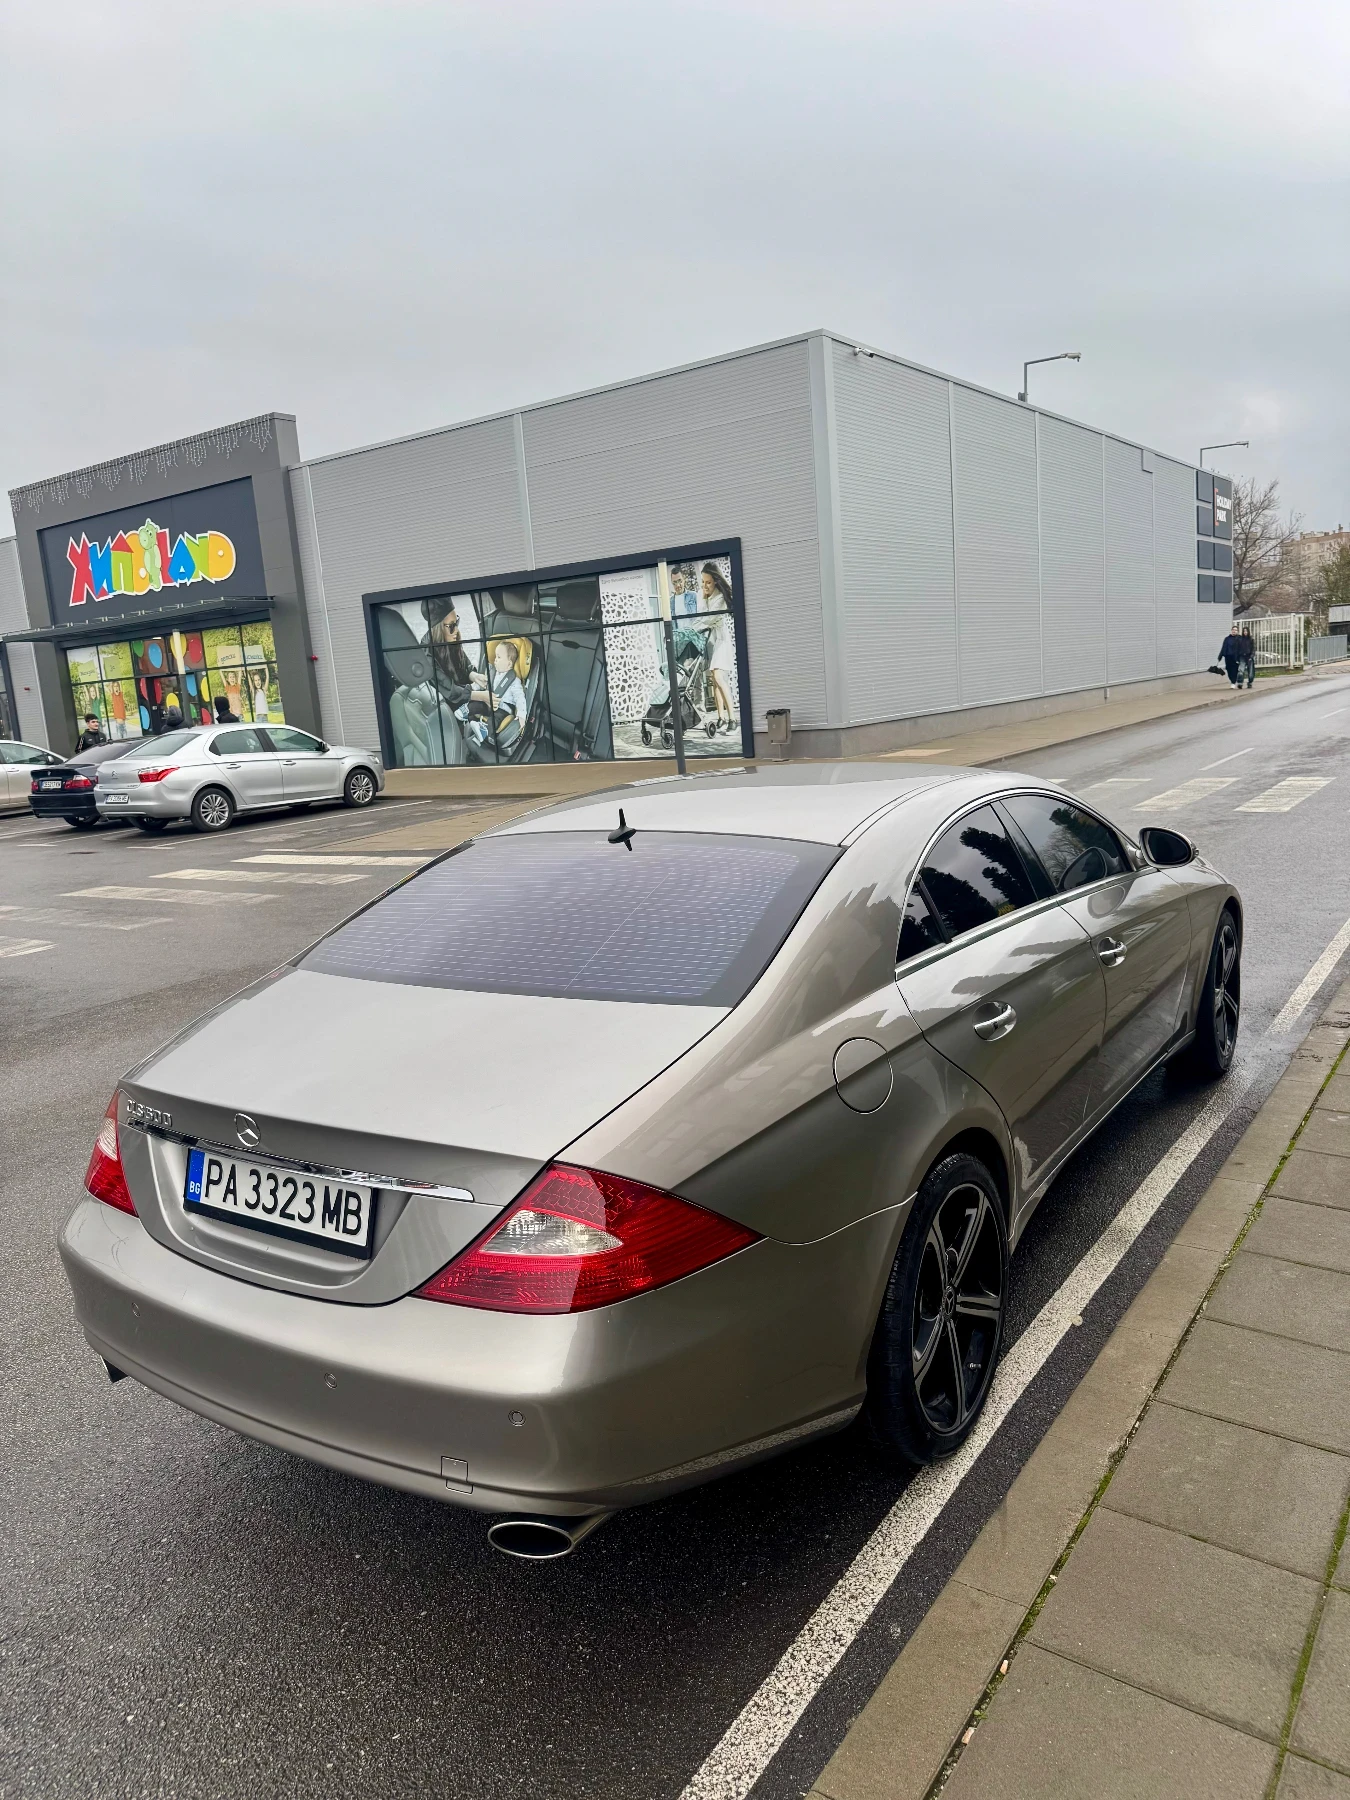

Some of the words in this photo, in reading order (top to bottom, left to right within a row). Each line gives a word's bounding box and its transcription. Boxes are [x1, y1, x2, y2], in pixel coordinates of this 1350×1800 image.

[1216, 509, 1227, 522] PARK
[189, 1181, 200, 1194] BG
[205, 1158, 238, 1206] PA
[244, 1168, 316, 1224] 3323
[321, 1185, 362, 1236] MB
